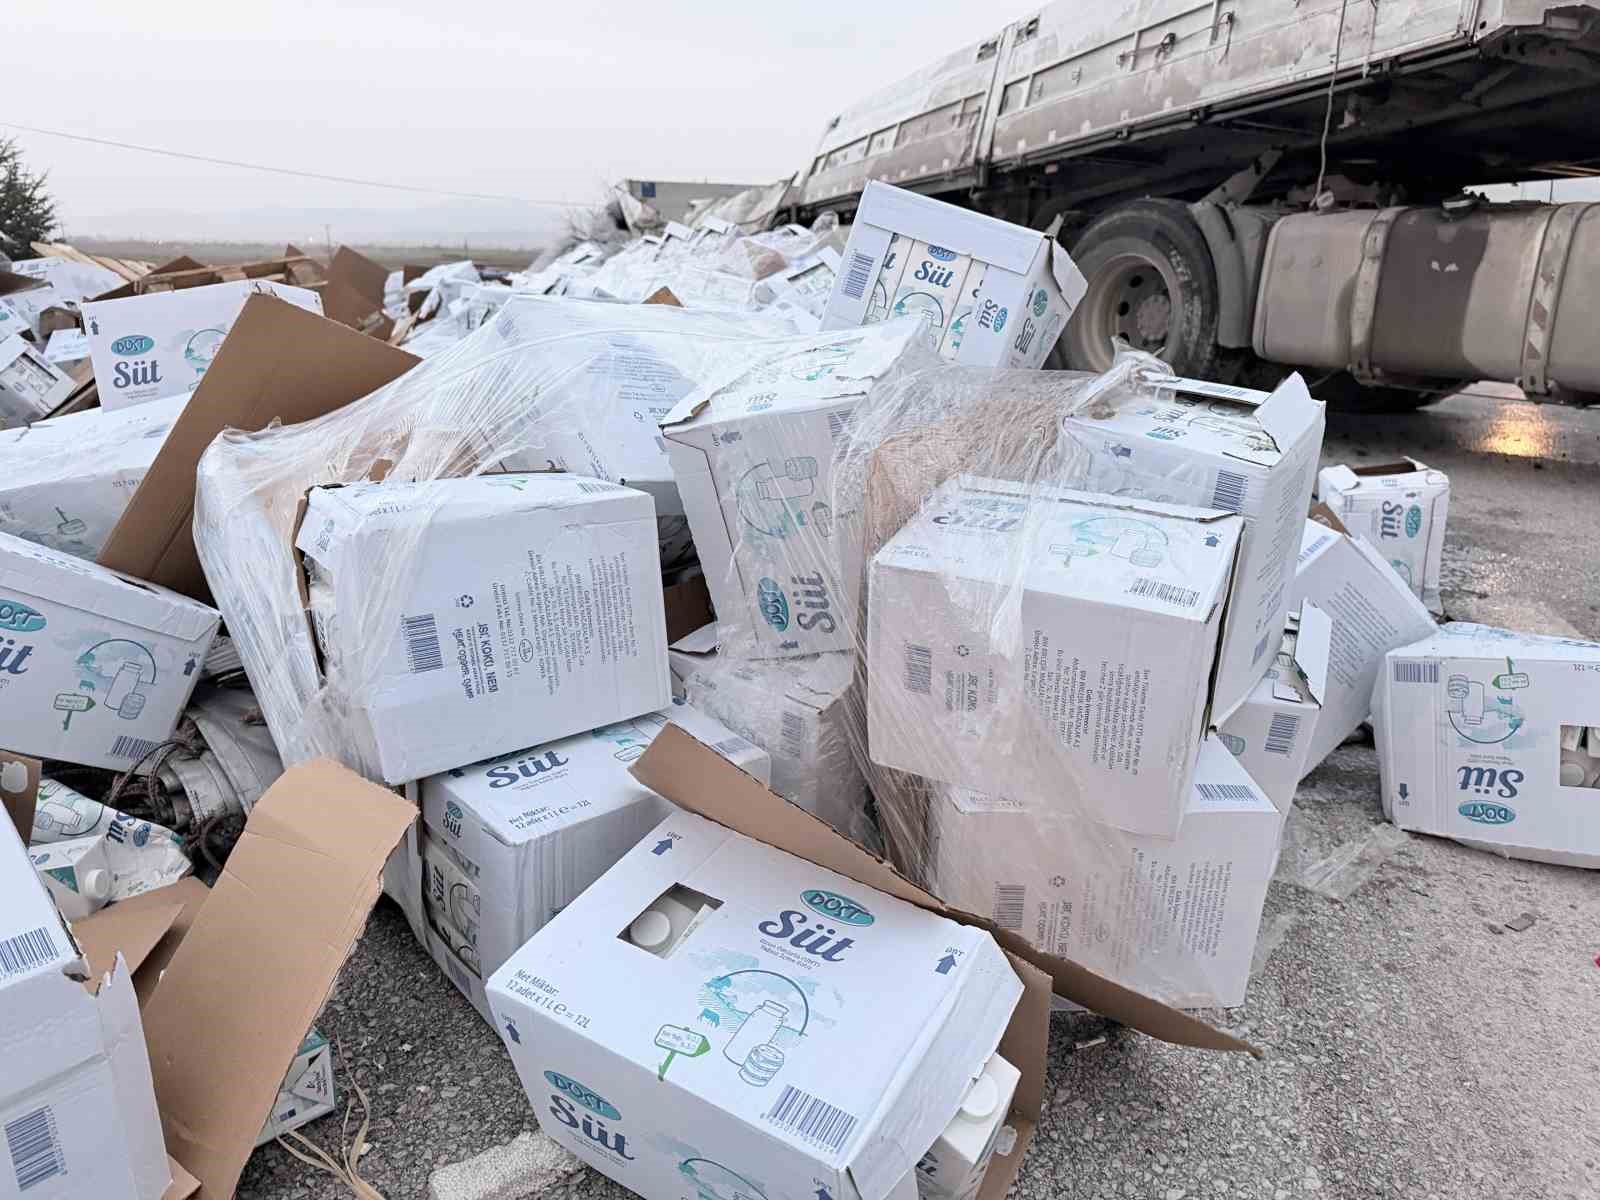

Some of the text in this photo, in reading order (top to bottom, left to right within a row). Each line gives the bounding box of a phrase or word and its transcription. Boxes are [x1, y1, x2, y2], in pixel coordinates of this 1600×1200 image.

[914, 260, 954, 288] Süt
[977, 299, 999, 328] Süt
[115, 337, 147, 354] DOST
[1014, 317, 1036, 354] Süt
[113, 359, 164, 389] Süt
[1380, 500, 1403, 539] Süt
[0, 604, 42, 625] OST
[791, 569, 836, 634] Süt
[0, 636, 33, 674] üt
[485, 749, 569, 789] Süt
[1457, 765, 1524, 798] Süt
[442, 812, 462, 839] Süt
[1468, 802, 1510, 824] DOST
[811, 893, 866, 919] DOST
[758, 910, 855, 962] Süt
[506, 979, 518, 991] 12
[515, 986, 536, 1001] adet
[514, 969, 560, 997] Net Miktar:
[553, 1074, 611, 1110] DOST
[549, 1094, 636, 1161] Süt
